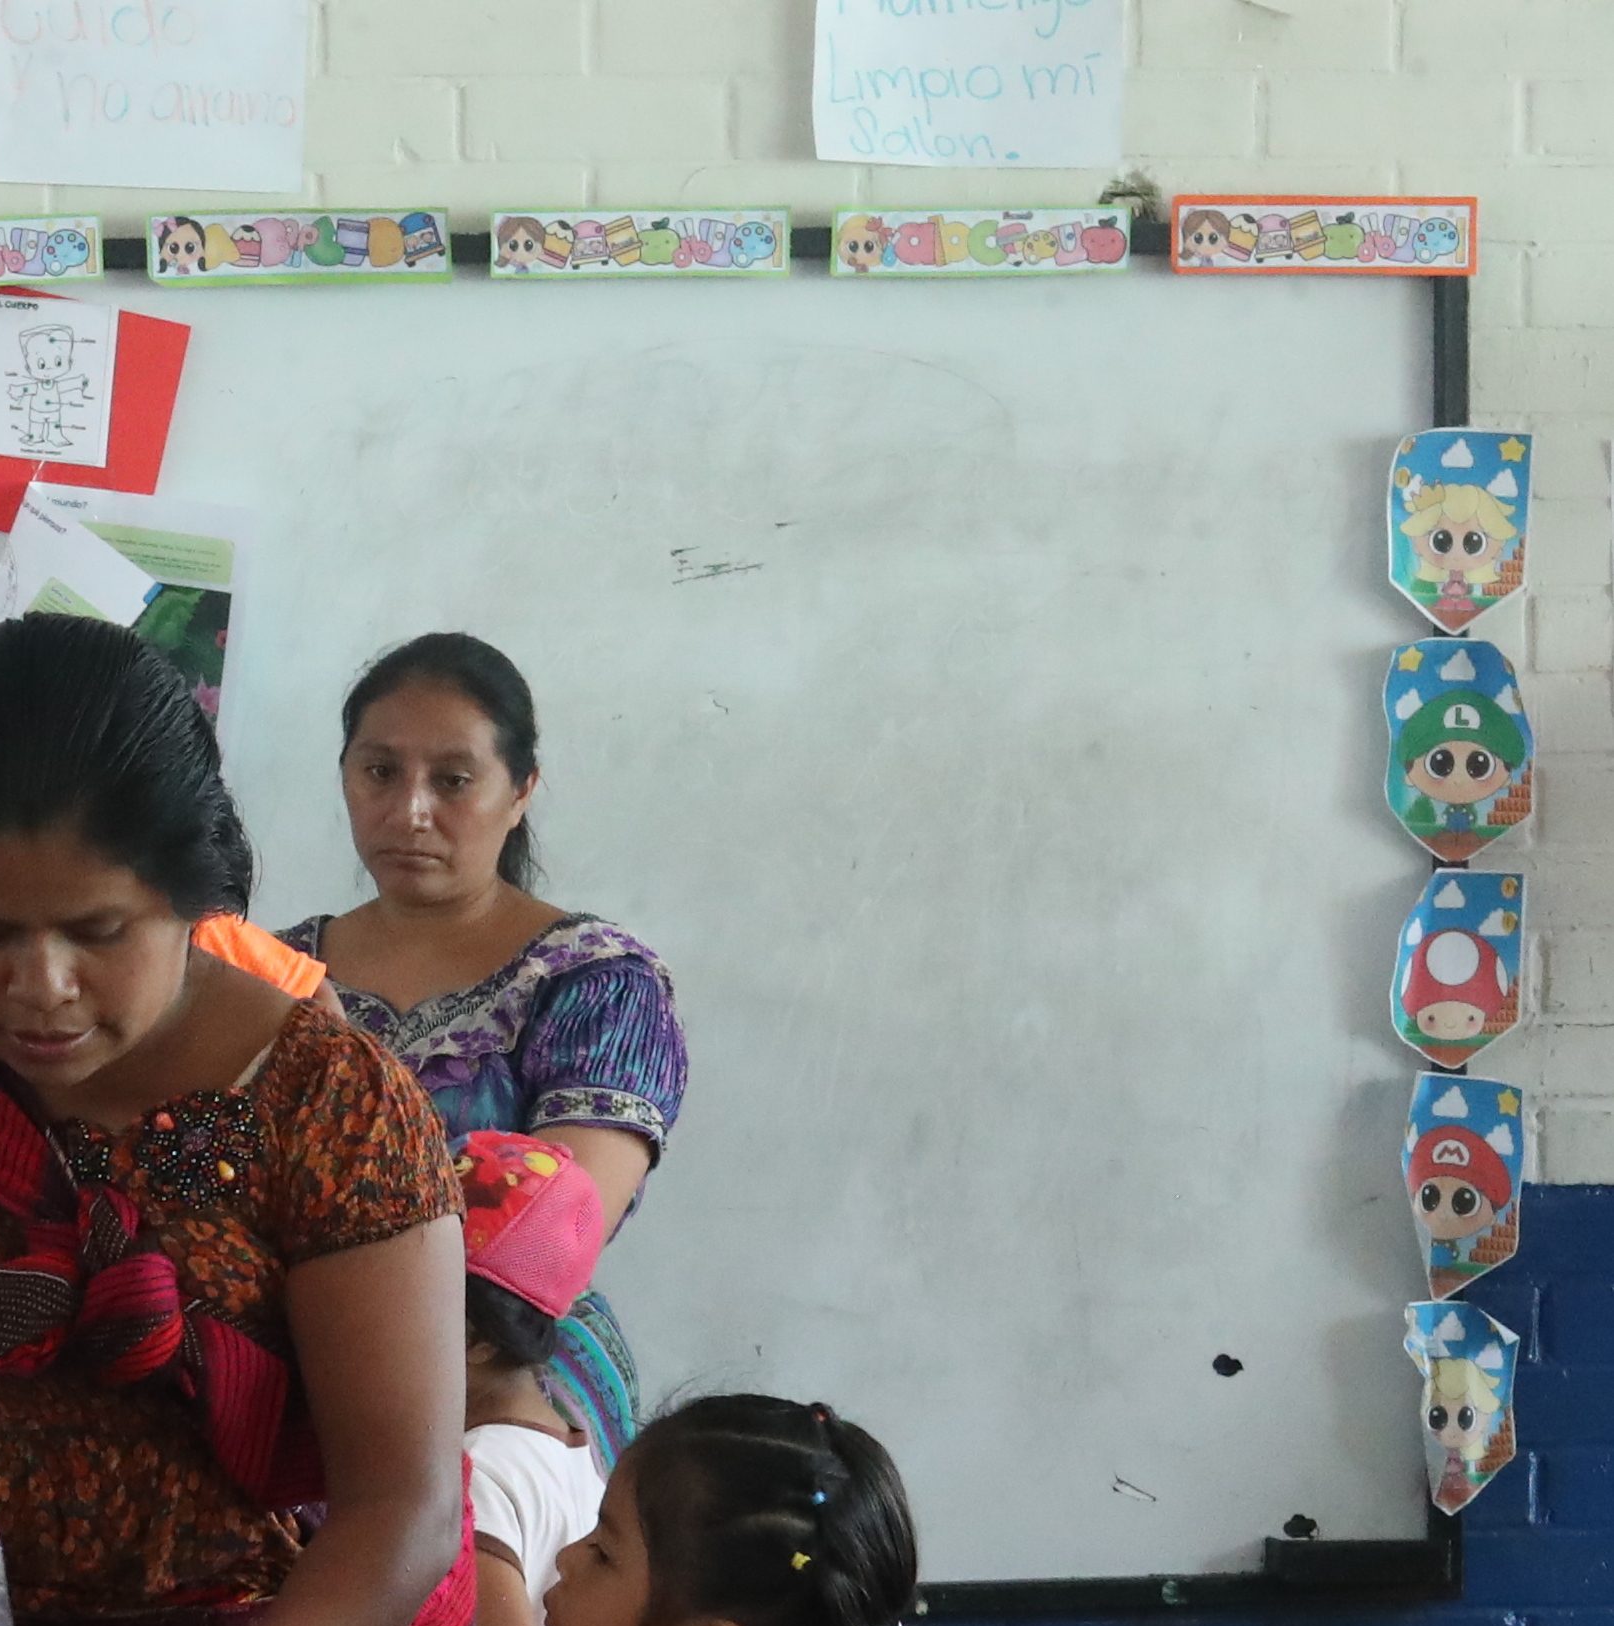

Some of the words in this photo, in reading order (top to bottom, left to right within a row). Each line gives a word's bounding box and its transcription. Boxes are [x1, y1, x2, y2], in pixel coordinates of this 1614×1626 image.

[828, 31, 1004, 125] Limpio
[56, 70, 130, 133] no
[5, 301, 39, 310] CUERPO
[51, 498, 88, 510] mundo?
[1454, 706, 1470, 727] L
[1437, 1144, 1465, 1163] M
